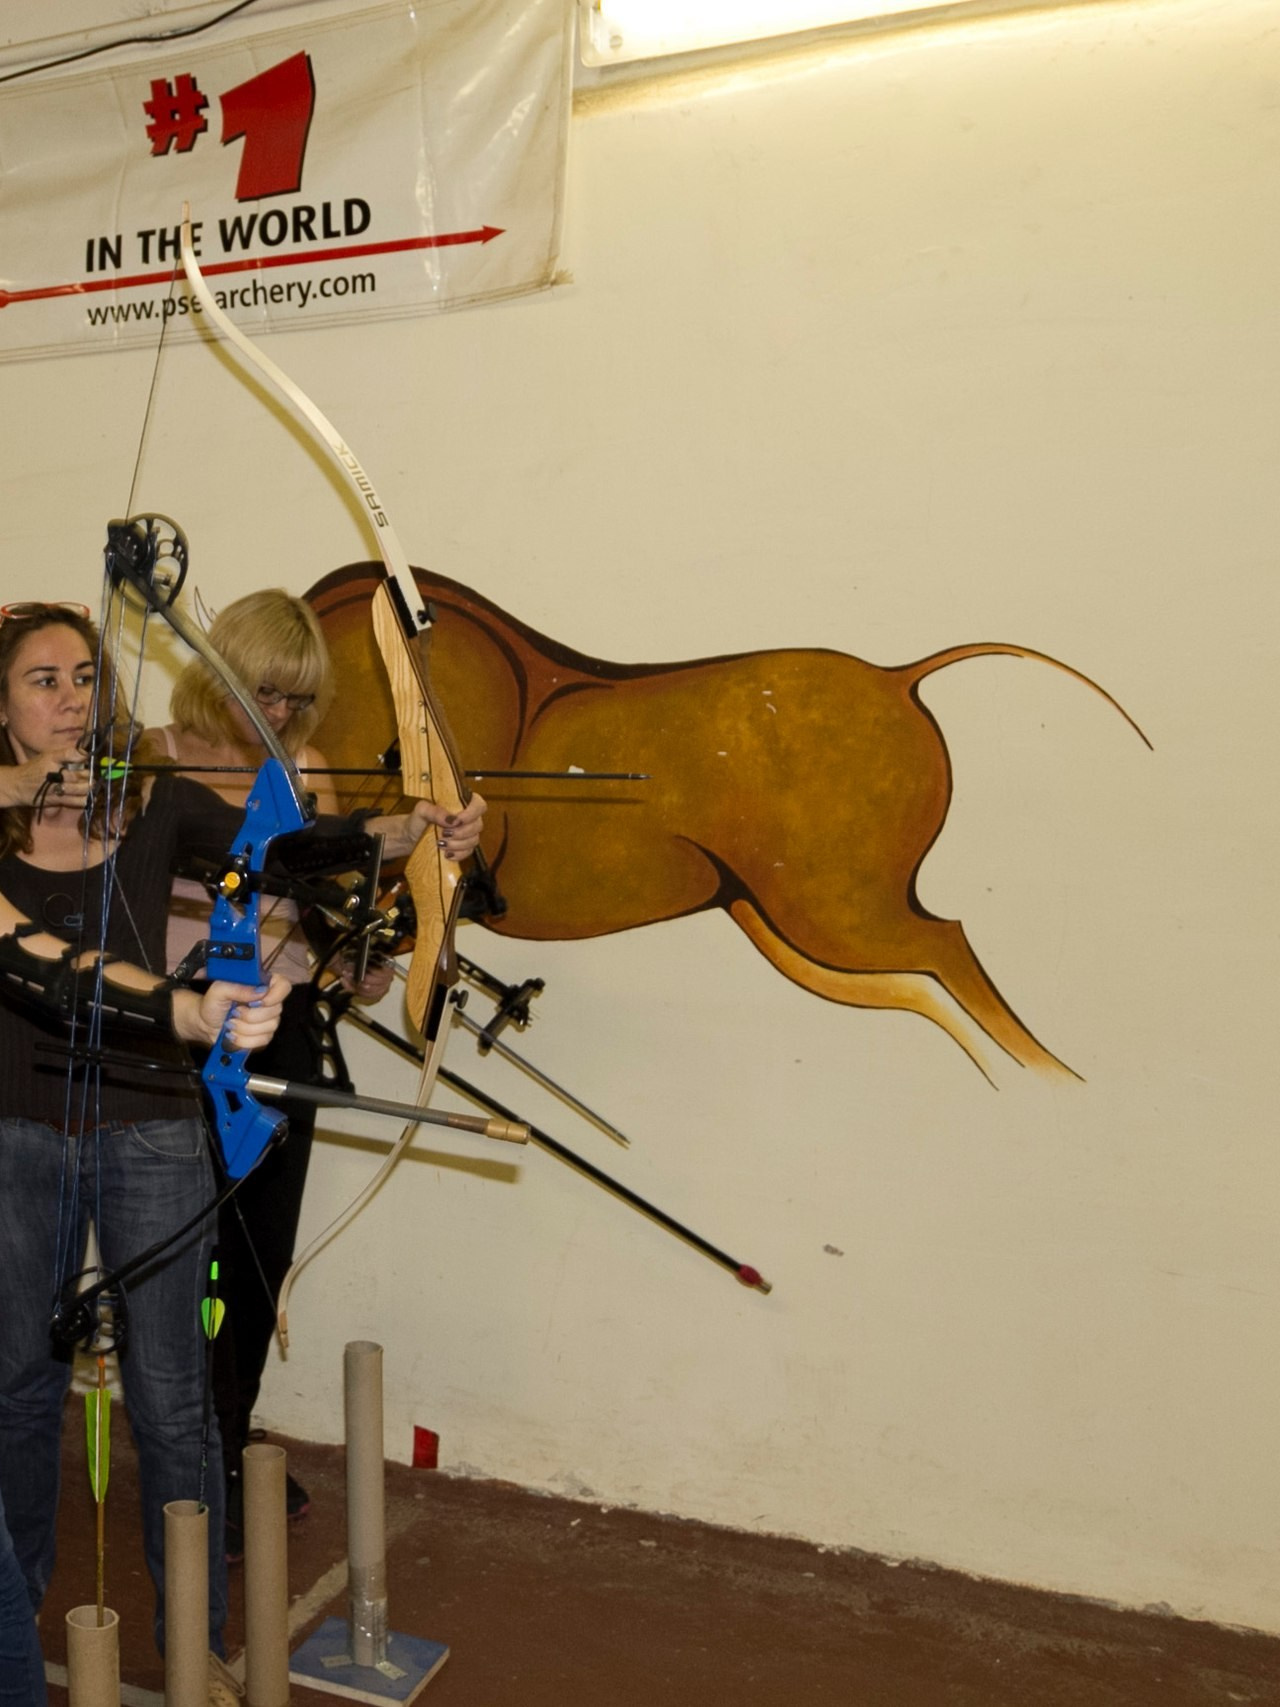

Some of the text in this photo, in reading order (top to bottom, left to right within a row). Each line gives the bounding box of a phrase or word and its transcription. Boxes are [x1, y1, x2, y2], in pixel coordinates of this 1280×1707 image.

[142, 49, 316, 203] #1
[85, 198, 372, 273] IN THE WORLD
[87, 271, 377, 325] www.psearchery.com
[333, 443, 390, 528] SAMICK
